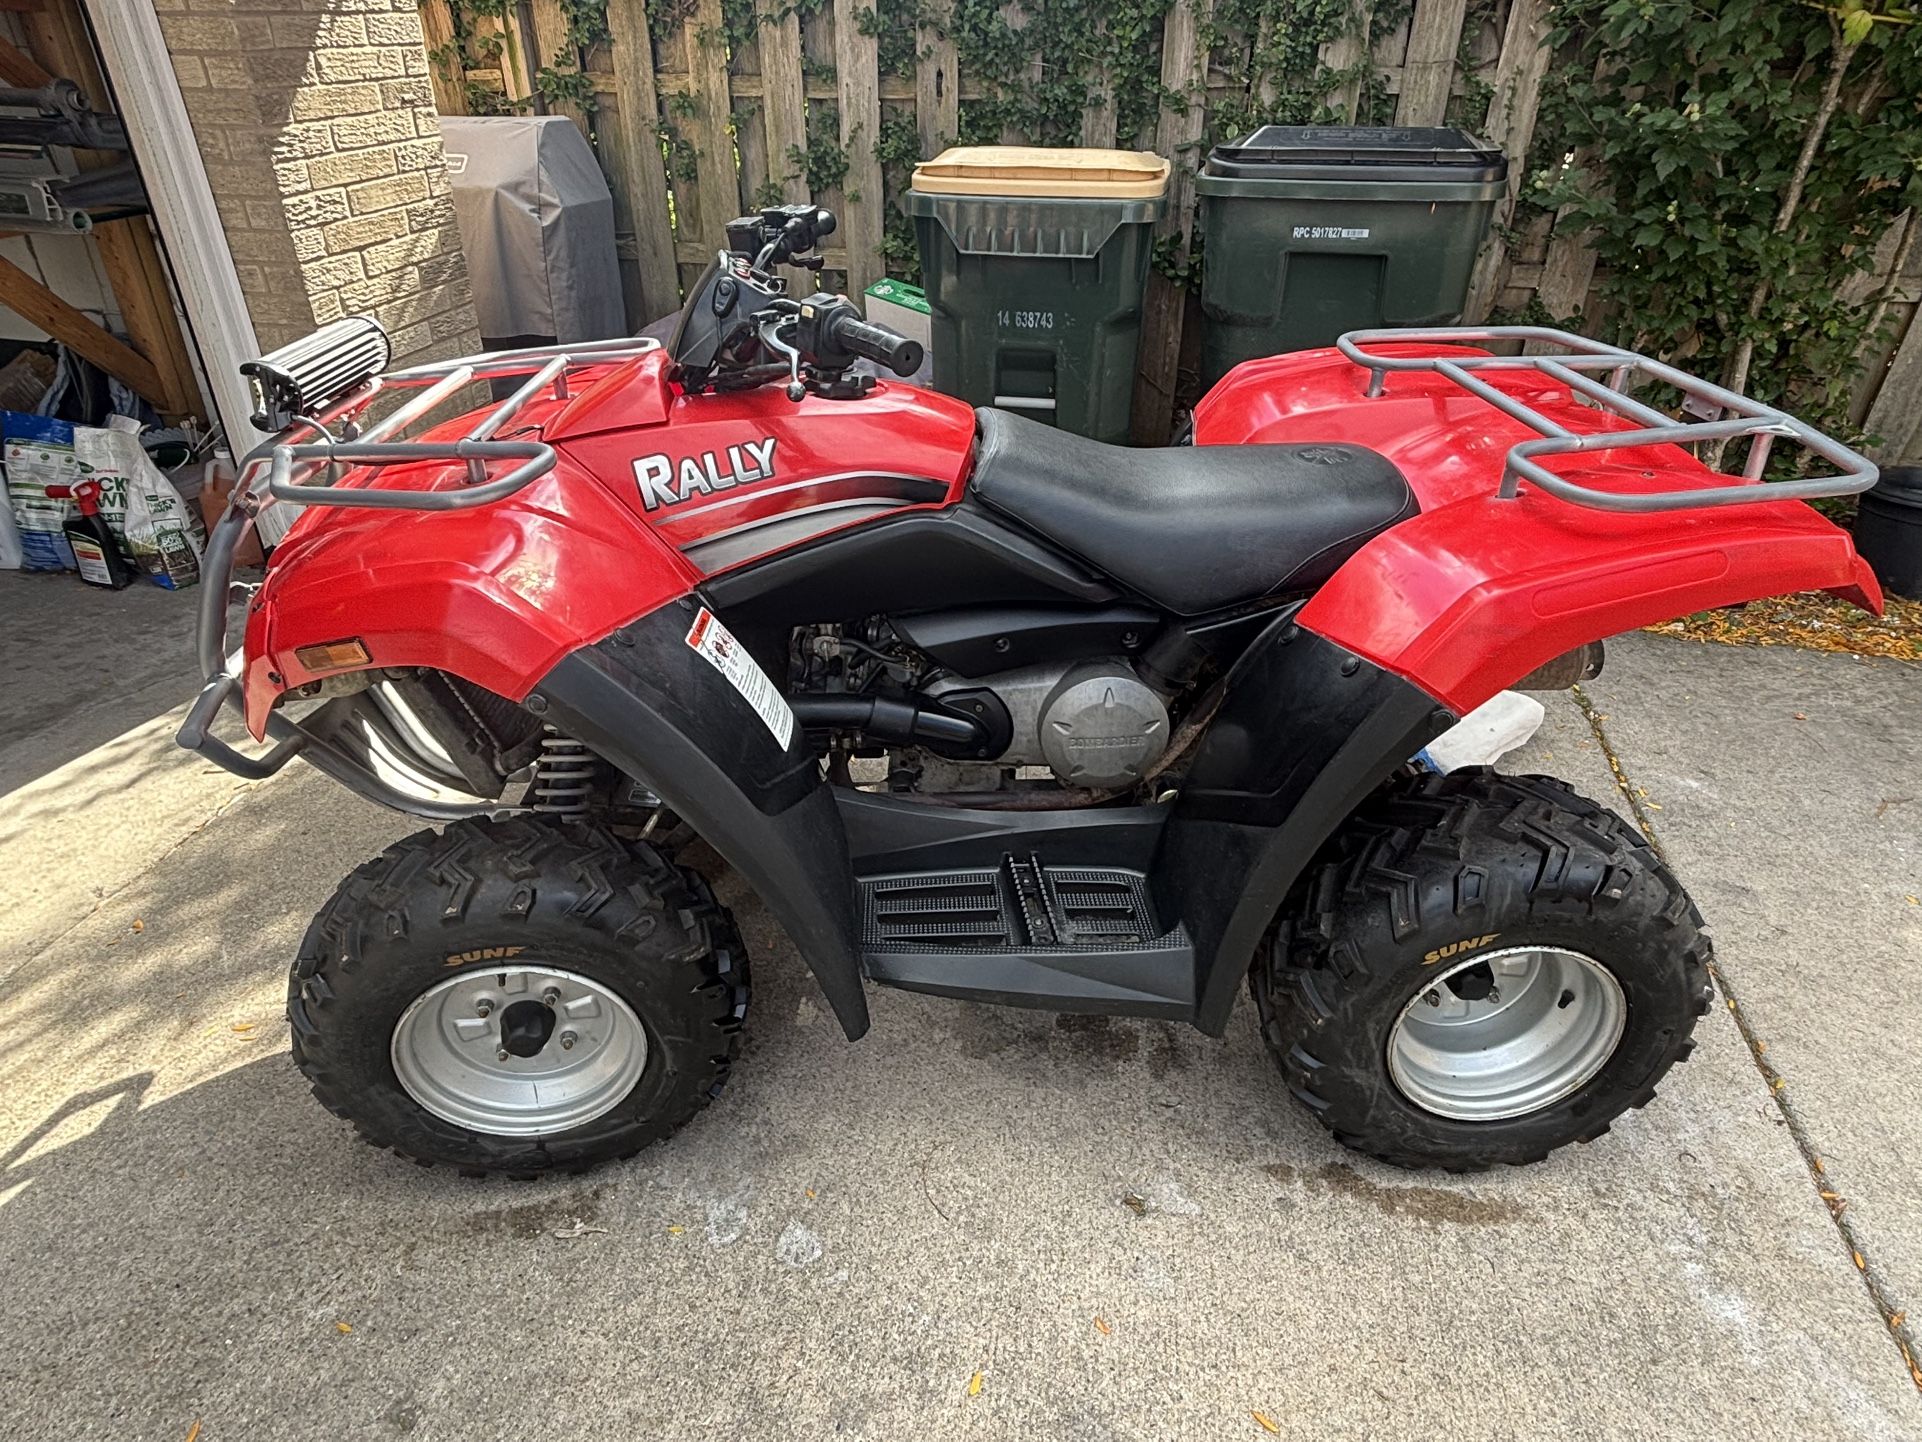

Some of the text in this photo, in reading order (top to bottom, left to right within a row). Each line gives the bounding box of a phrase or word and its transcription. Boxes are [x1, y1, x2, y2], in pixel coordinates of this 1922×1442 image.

[1293, 227, 1342, 238] RPC 5017827
[997, 310, 1053, 329] 14 638743
[632, 437, 777, 511] RALLY
[443, 946, 528, 967] SUNF
[1420, 933, 1502, 966] SUNF
